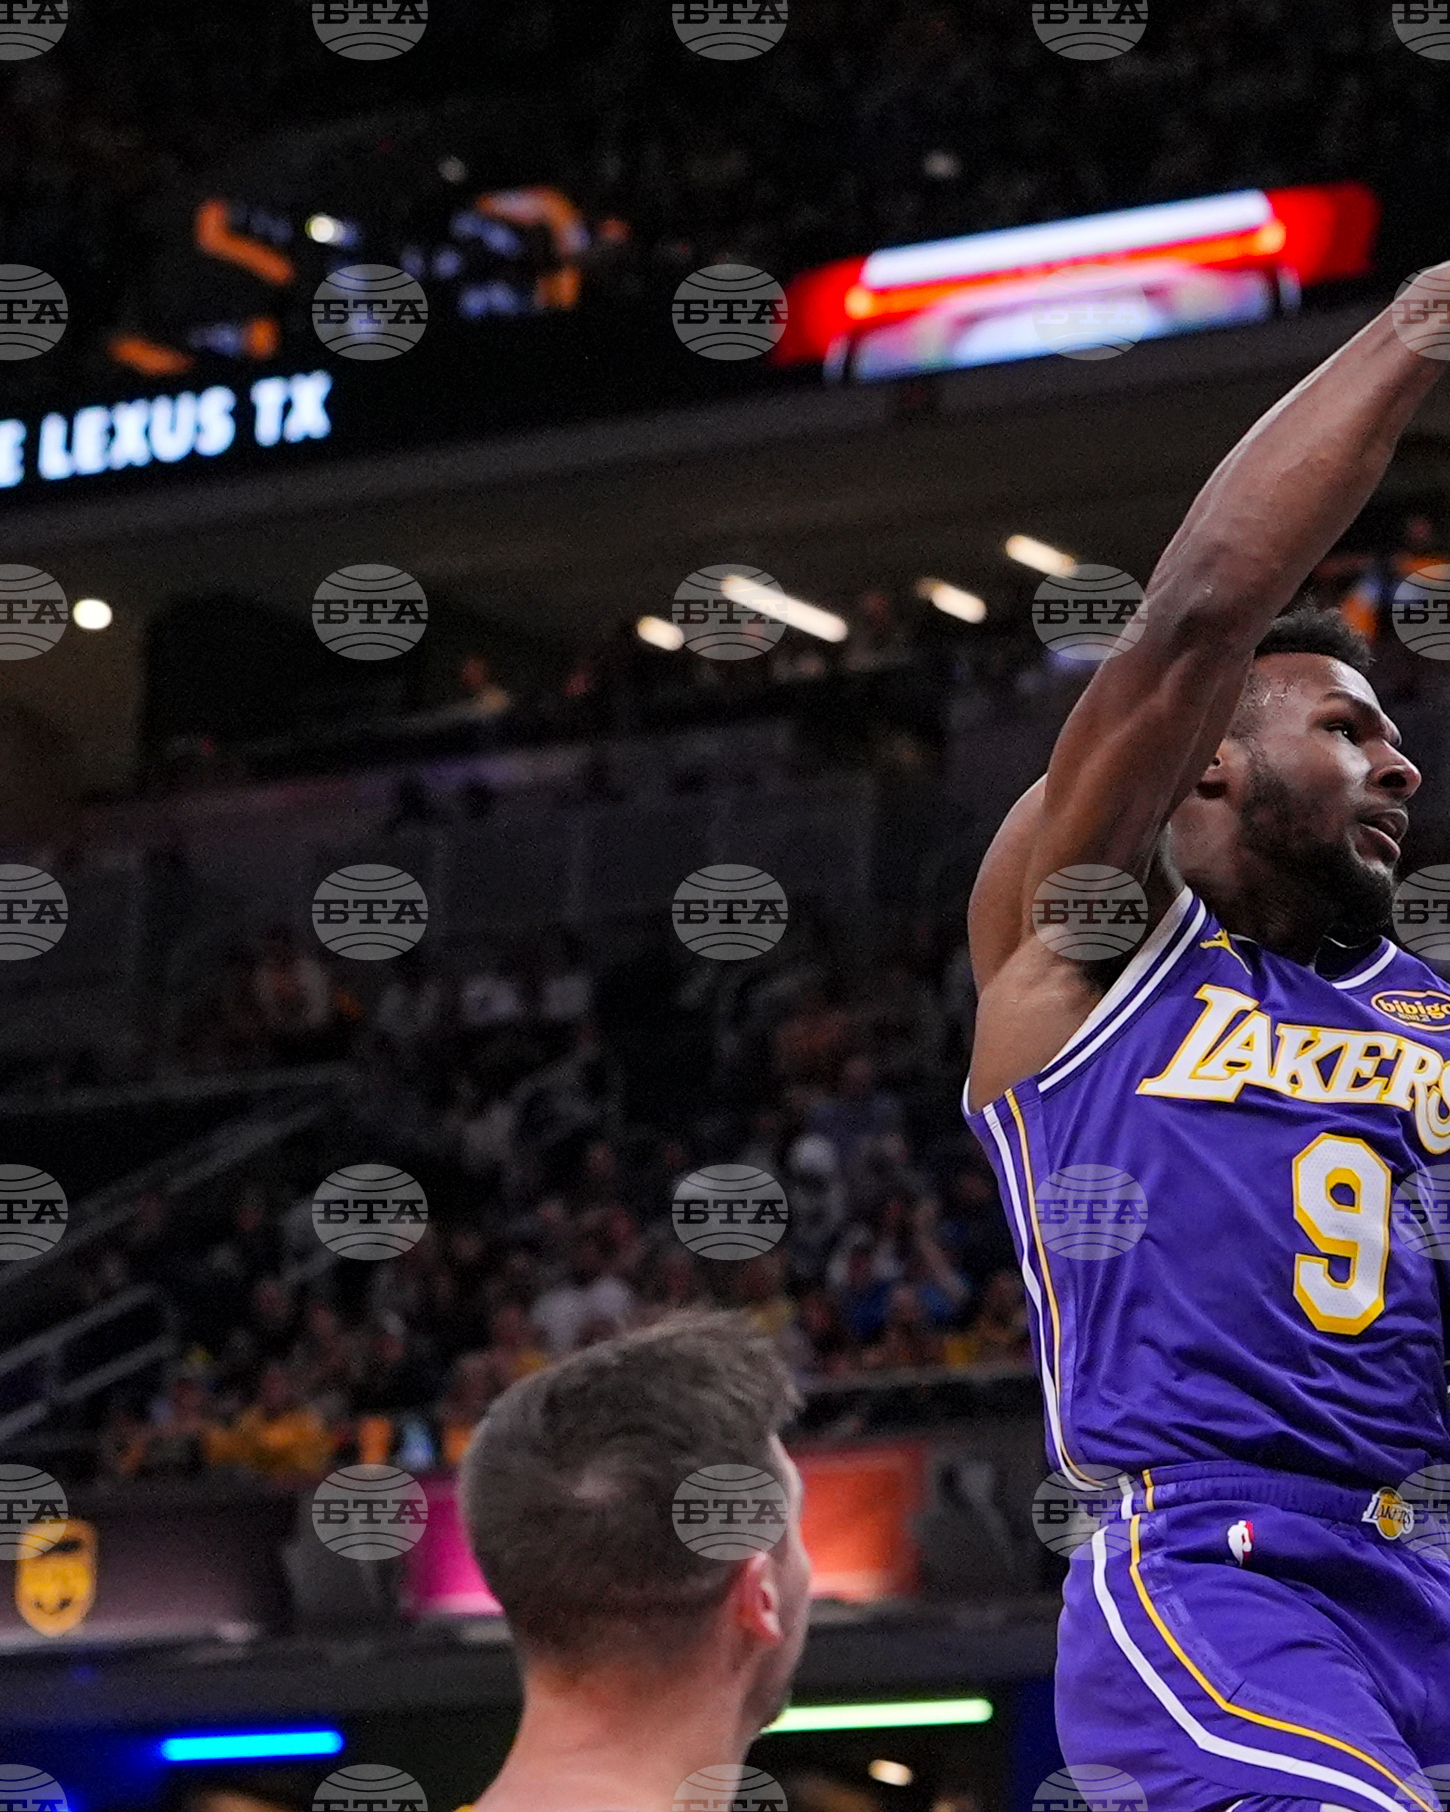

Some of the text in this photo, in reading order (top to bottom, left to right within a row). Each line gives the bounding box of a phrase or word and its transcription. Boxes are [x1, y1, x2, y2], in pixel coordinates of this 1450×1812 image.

[38, 385, 236, 480] LEXUS
[250, 369, 333, 447] TX
[1292, 1132, 1391, 1335] 9
